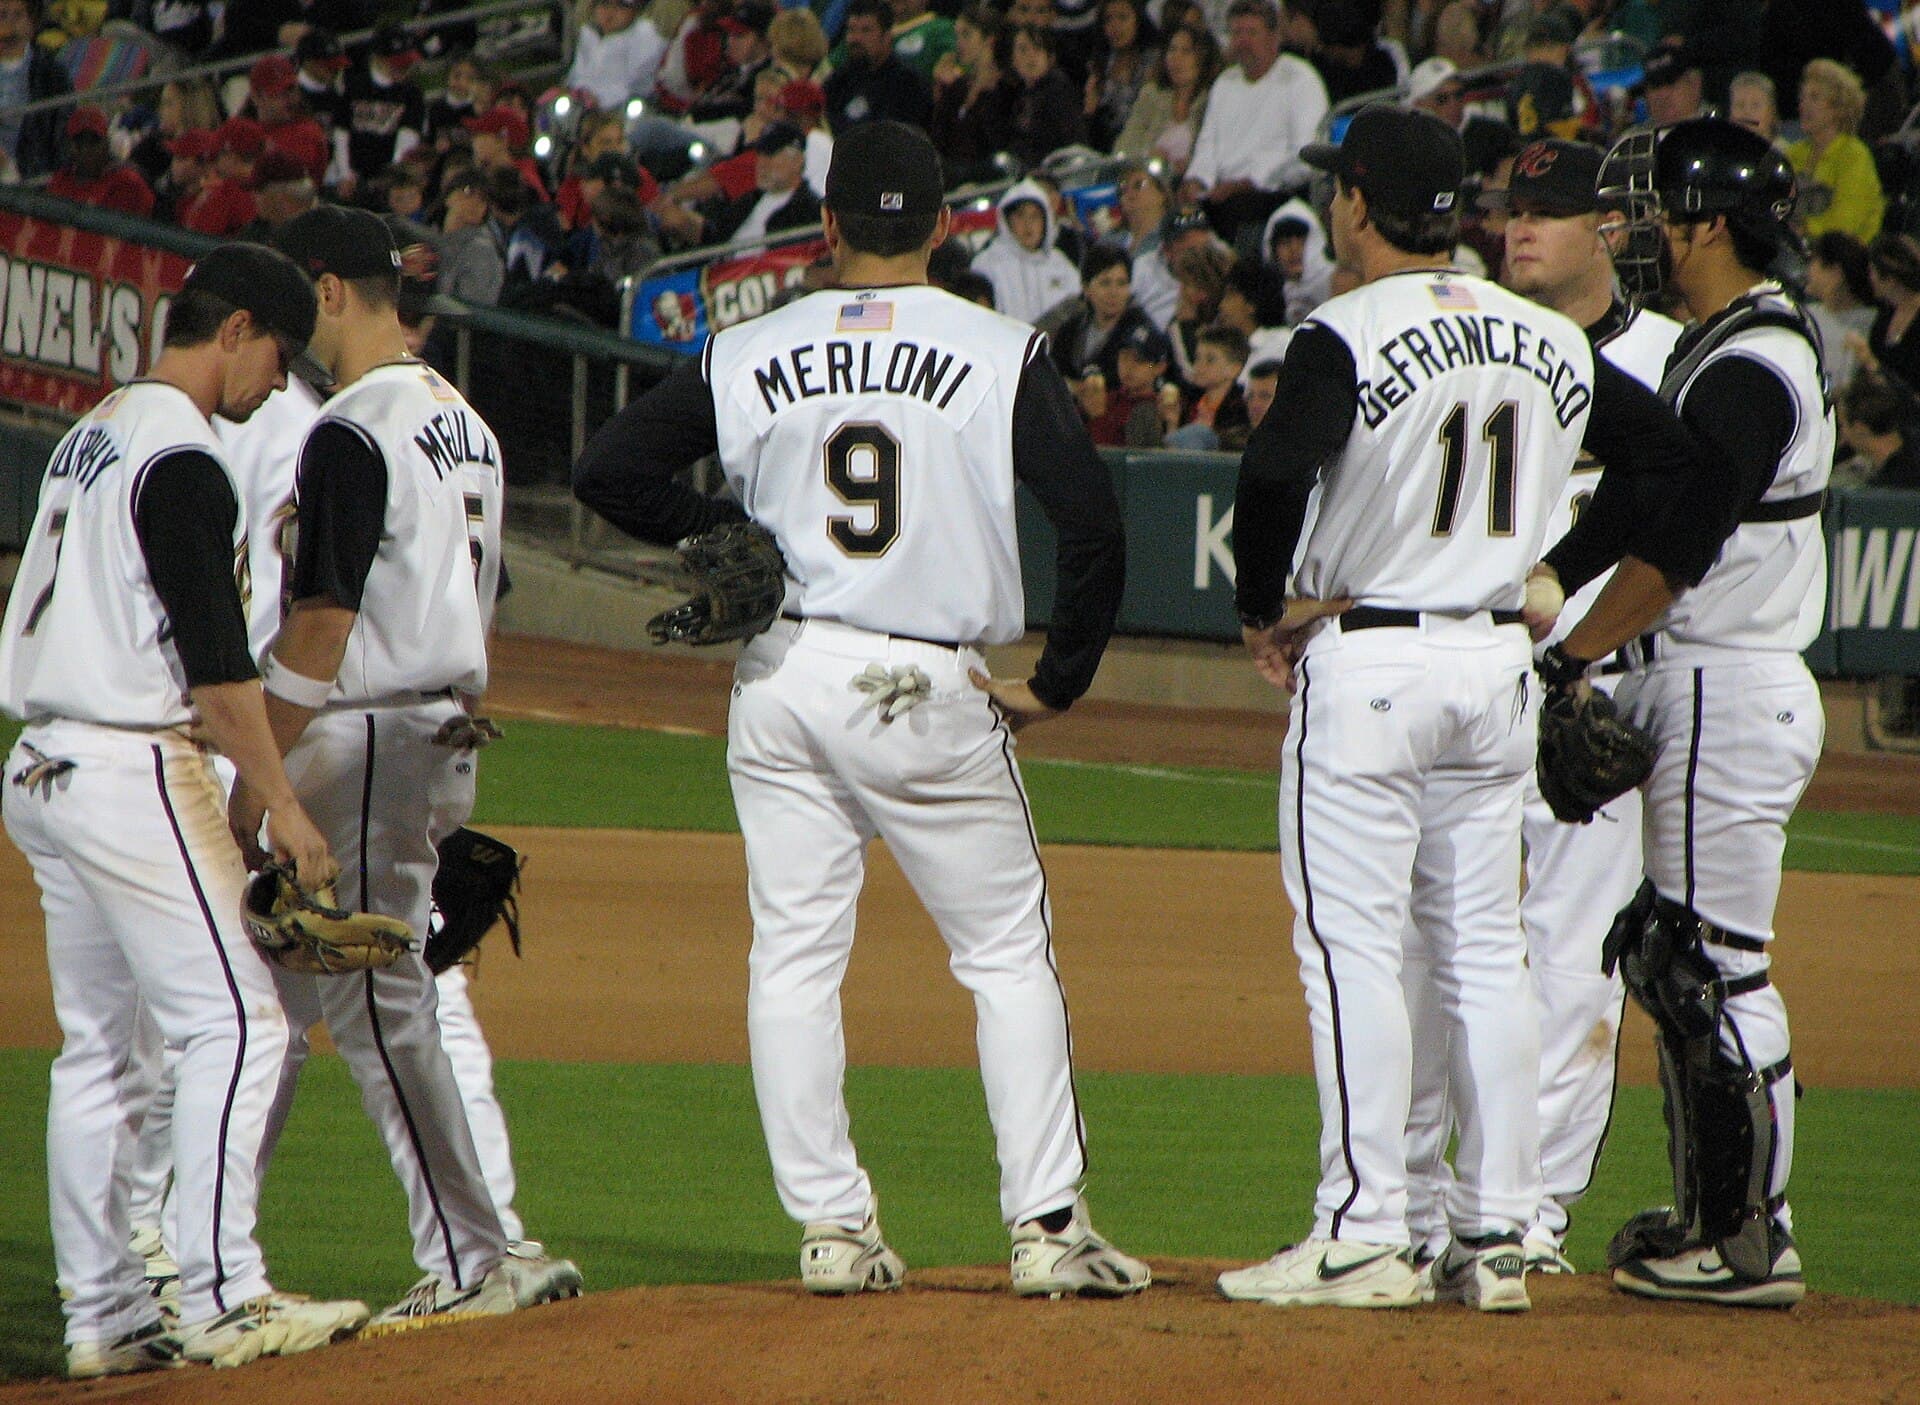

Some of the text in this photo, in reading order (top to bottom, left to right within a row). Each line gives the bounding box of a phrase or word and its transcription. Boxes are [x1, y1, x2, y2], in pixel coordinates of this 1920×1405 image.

[754, 341, 973, 415] MERLONI
[823, 420, 902, 559] 9
[1430, 399, 1520, 538] 11
[21, 506, 69, 637] 7
